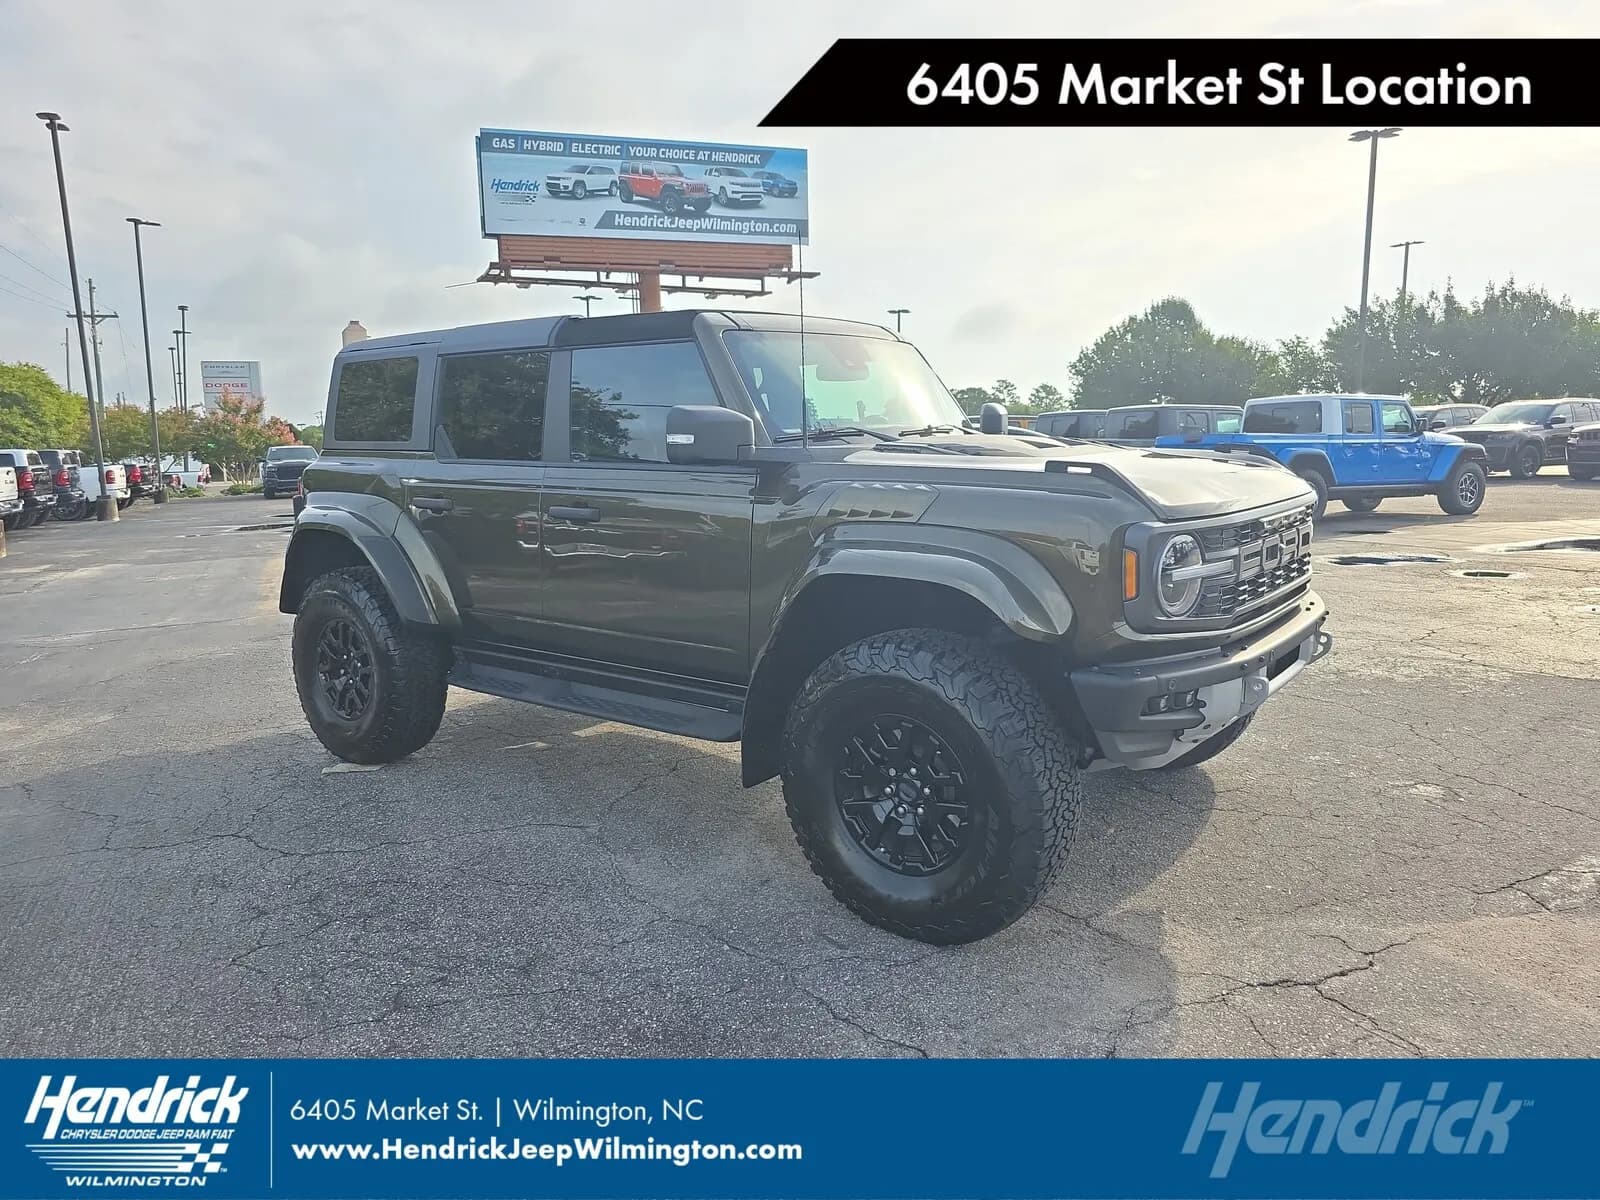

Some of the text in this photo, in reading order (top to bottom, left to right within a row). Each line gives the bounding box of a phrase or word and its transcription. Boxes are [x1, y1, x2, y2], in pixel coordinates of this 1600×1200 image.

[492, 137, 761, 165] GAS HYBRID ELECTRIC YOUR CHOICE AT HENDRICK
[490, 178, 541, 194] Hendrick
[614, 213, 798, 234] HendrickJeepWilmington.com
[1240, 522, 1313, 580] FORD
